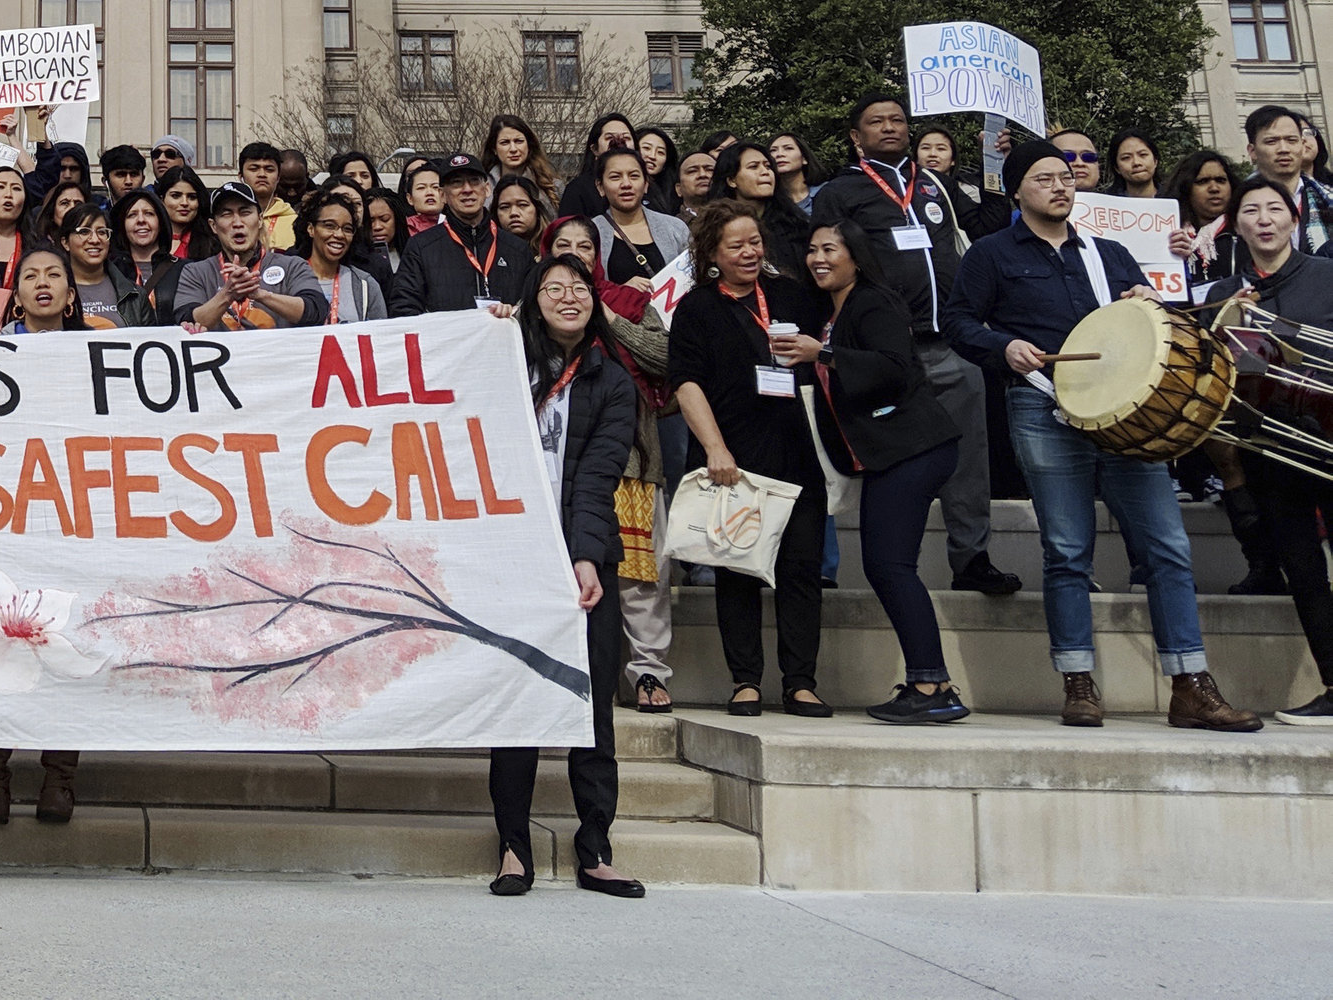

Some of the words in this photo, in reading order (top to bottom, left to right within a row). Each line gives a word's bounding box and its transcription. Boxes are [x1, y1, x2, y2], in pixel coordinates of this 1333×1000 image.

[939, 25, 1019, 65] ASIAN
[48, 78, 92, 101] ICE
[921, 54, 1033, 89] american
[911, 68, 1043, 133] POWER
[1068, 201, 1176, 236] REEDOM
[82, 304, 117, 313] NCING
[88, 340, 242, 415] FOR
[311, 333, 455, 408] ALL
[305, 417, 525, 526] CALL
